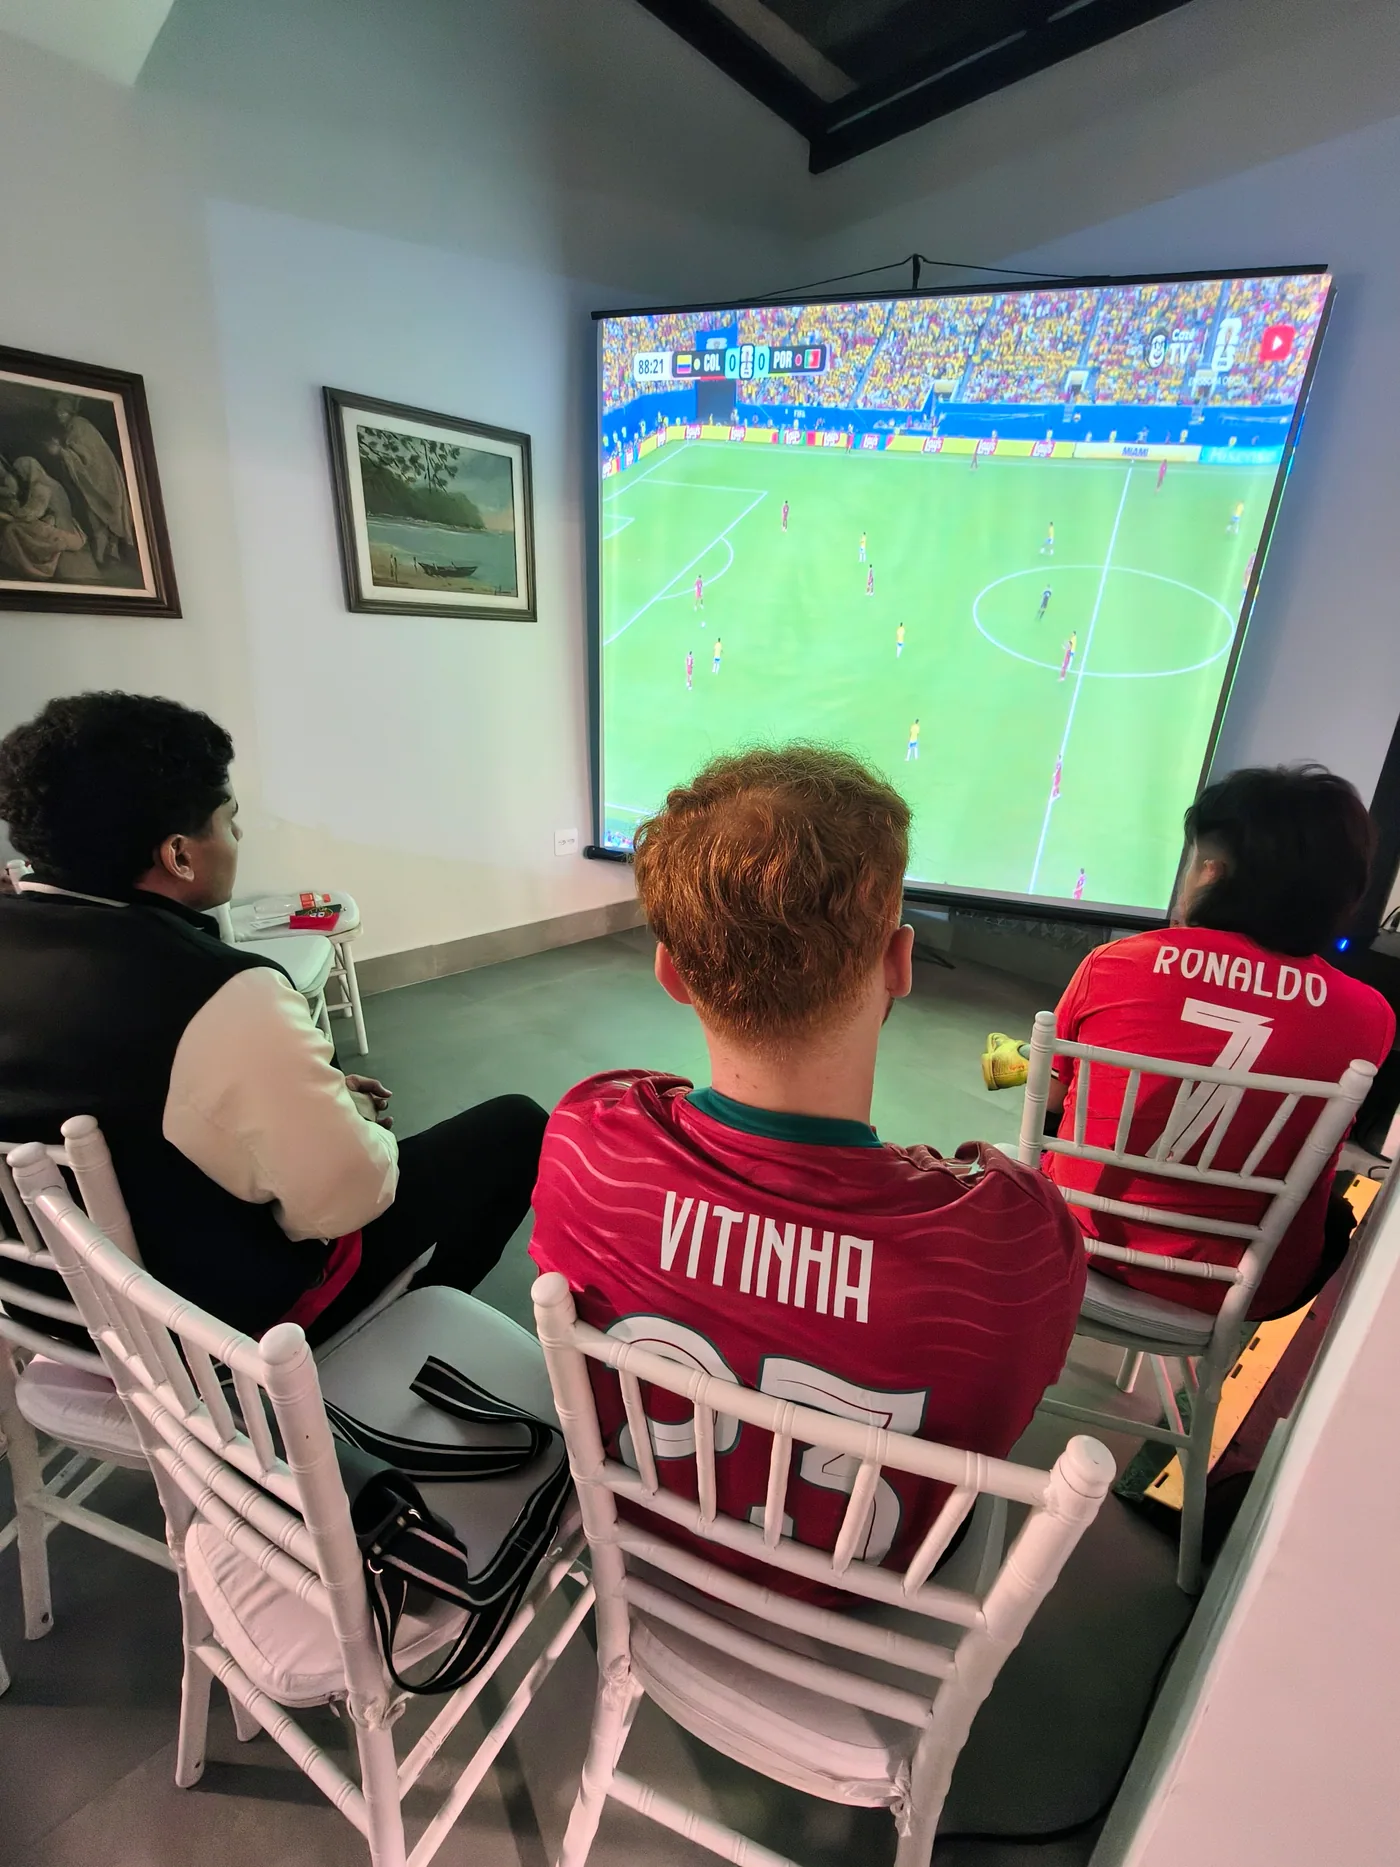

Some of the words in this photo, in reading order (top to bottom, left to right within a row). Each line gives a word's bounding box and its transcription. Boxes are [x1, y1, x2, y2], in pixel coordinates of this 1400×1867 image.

[638, 358, 664, 374] 88:21
[704, 353, 720, 372] COL
[729, 354, 736, 372] 0
[758, 353, 765, 370] 0
[773, 350, 792, 369] POR
[1169, 343, 1193, 365] TV
[1122, 447, 1149, 457] MIAMI
[1153, 945, 1328, 1007] RONALDO
[1145, 997, 1274, 1164] 7
[660, 1190, 874, 1323] VITINHA
